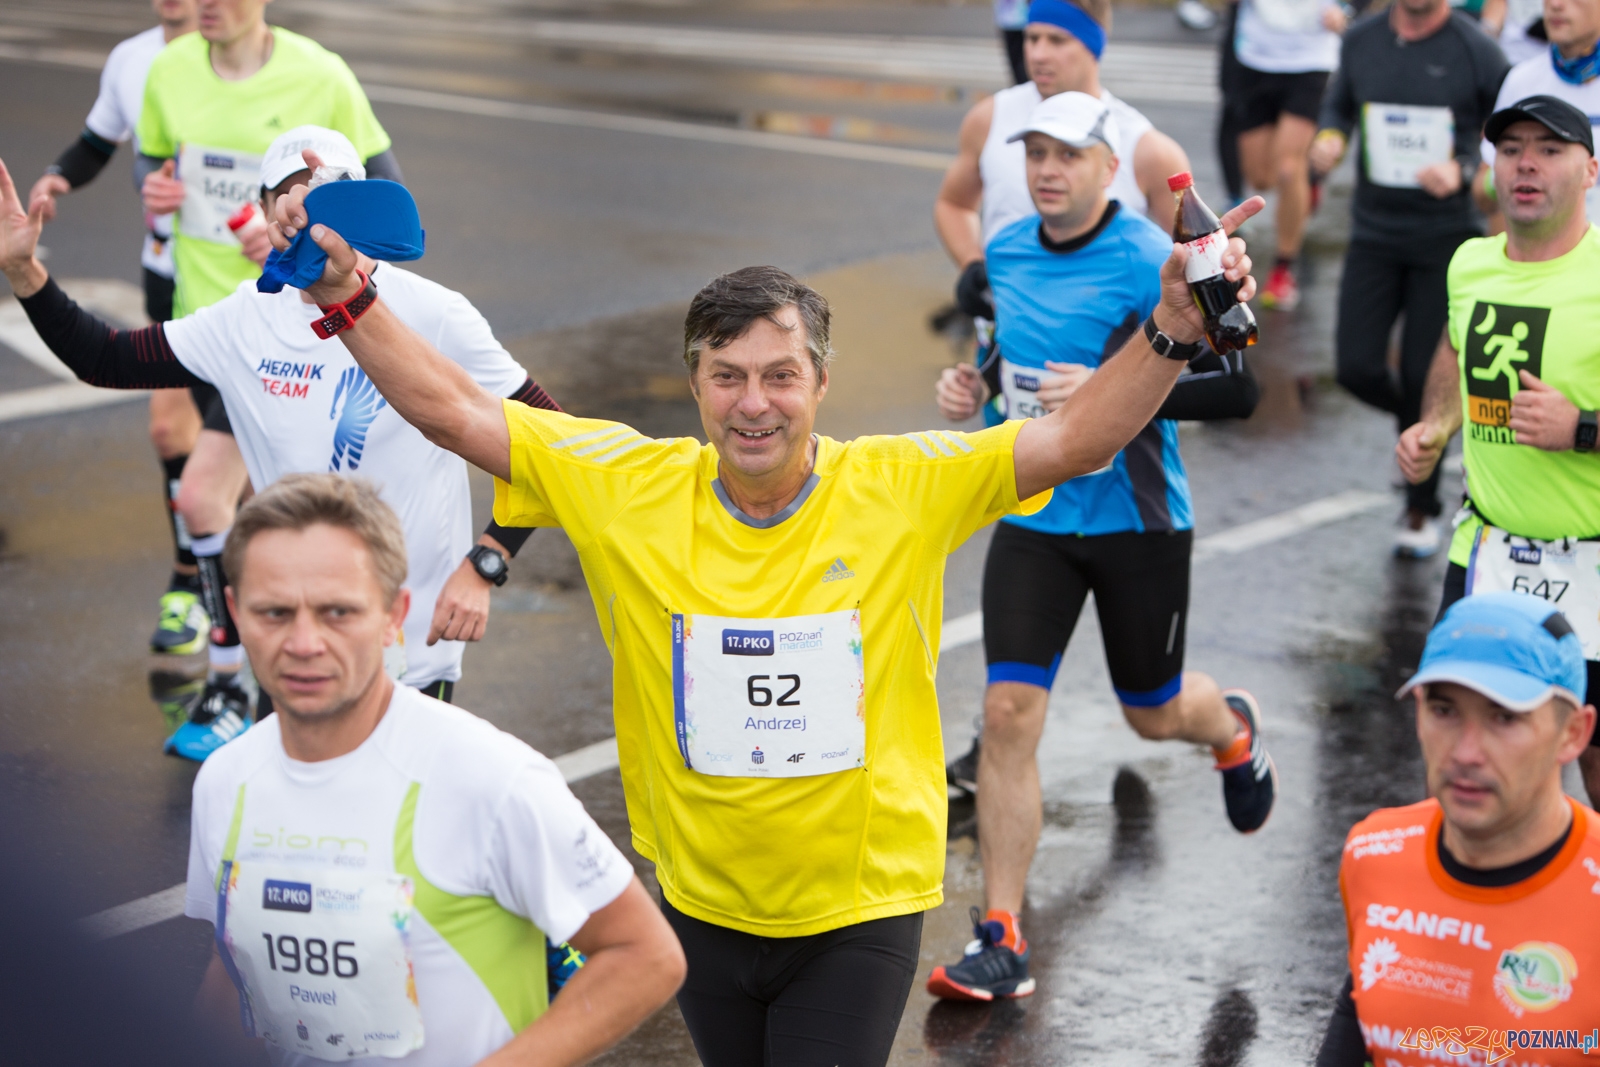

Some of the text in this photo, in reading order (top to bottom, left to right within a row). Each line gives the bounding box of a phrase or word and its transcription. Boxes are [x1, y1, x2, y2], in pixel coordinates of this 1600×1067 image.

[257, 358, 325, 380] HERNIK
[261, 378, 309, 398] TEAM
[822, 570, 855, 583] adidas
[1512, 575, 1569, 603] 647
[780, 640, 822, 650] maraton
[747, 674, 801, 707] 62
[744, 715, 807, 731] Andrzej
[1366, 903, 1493, 951] SCANFIL
[262, 932, 358, 979] 1986
[289, 984, 337, 1006] Paweł
